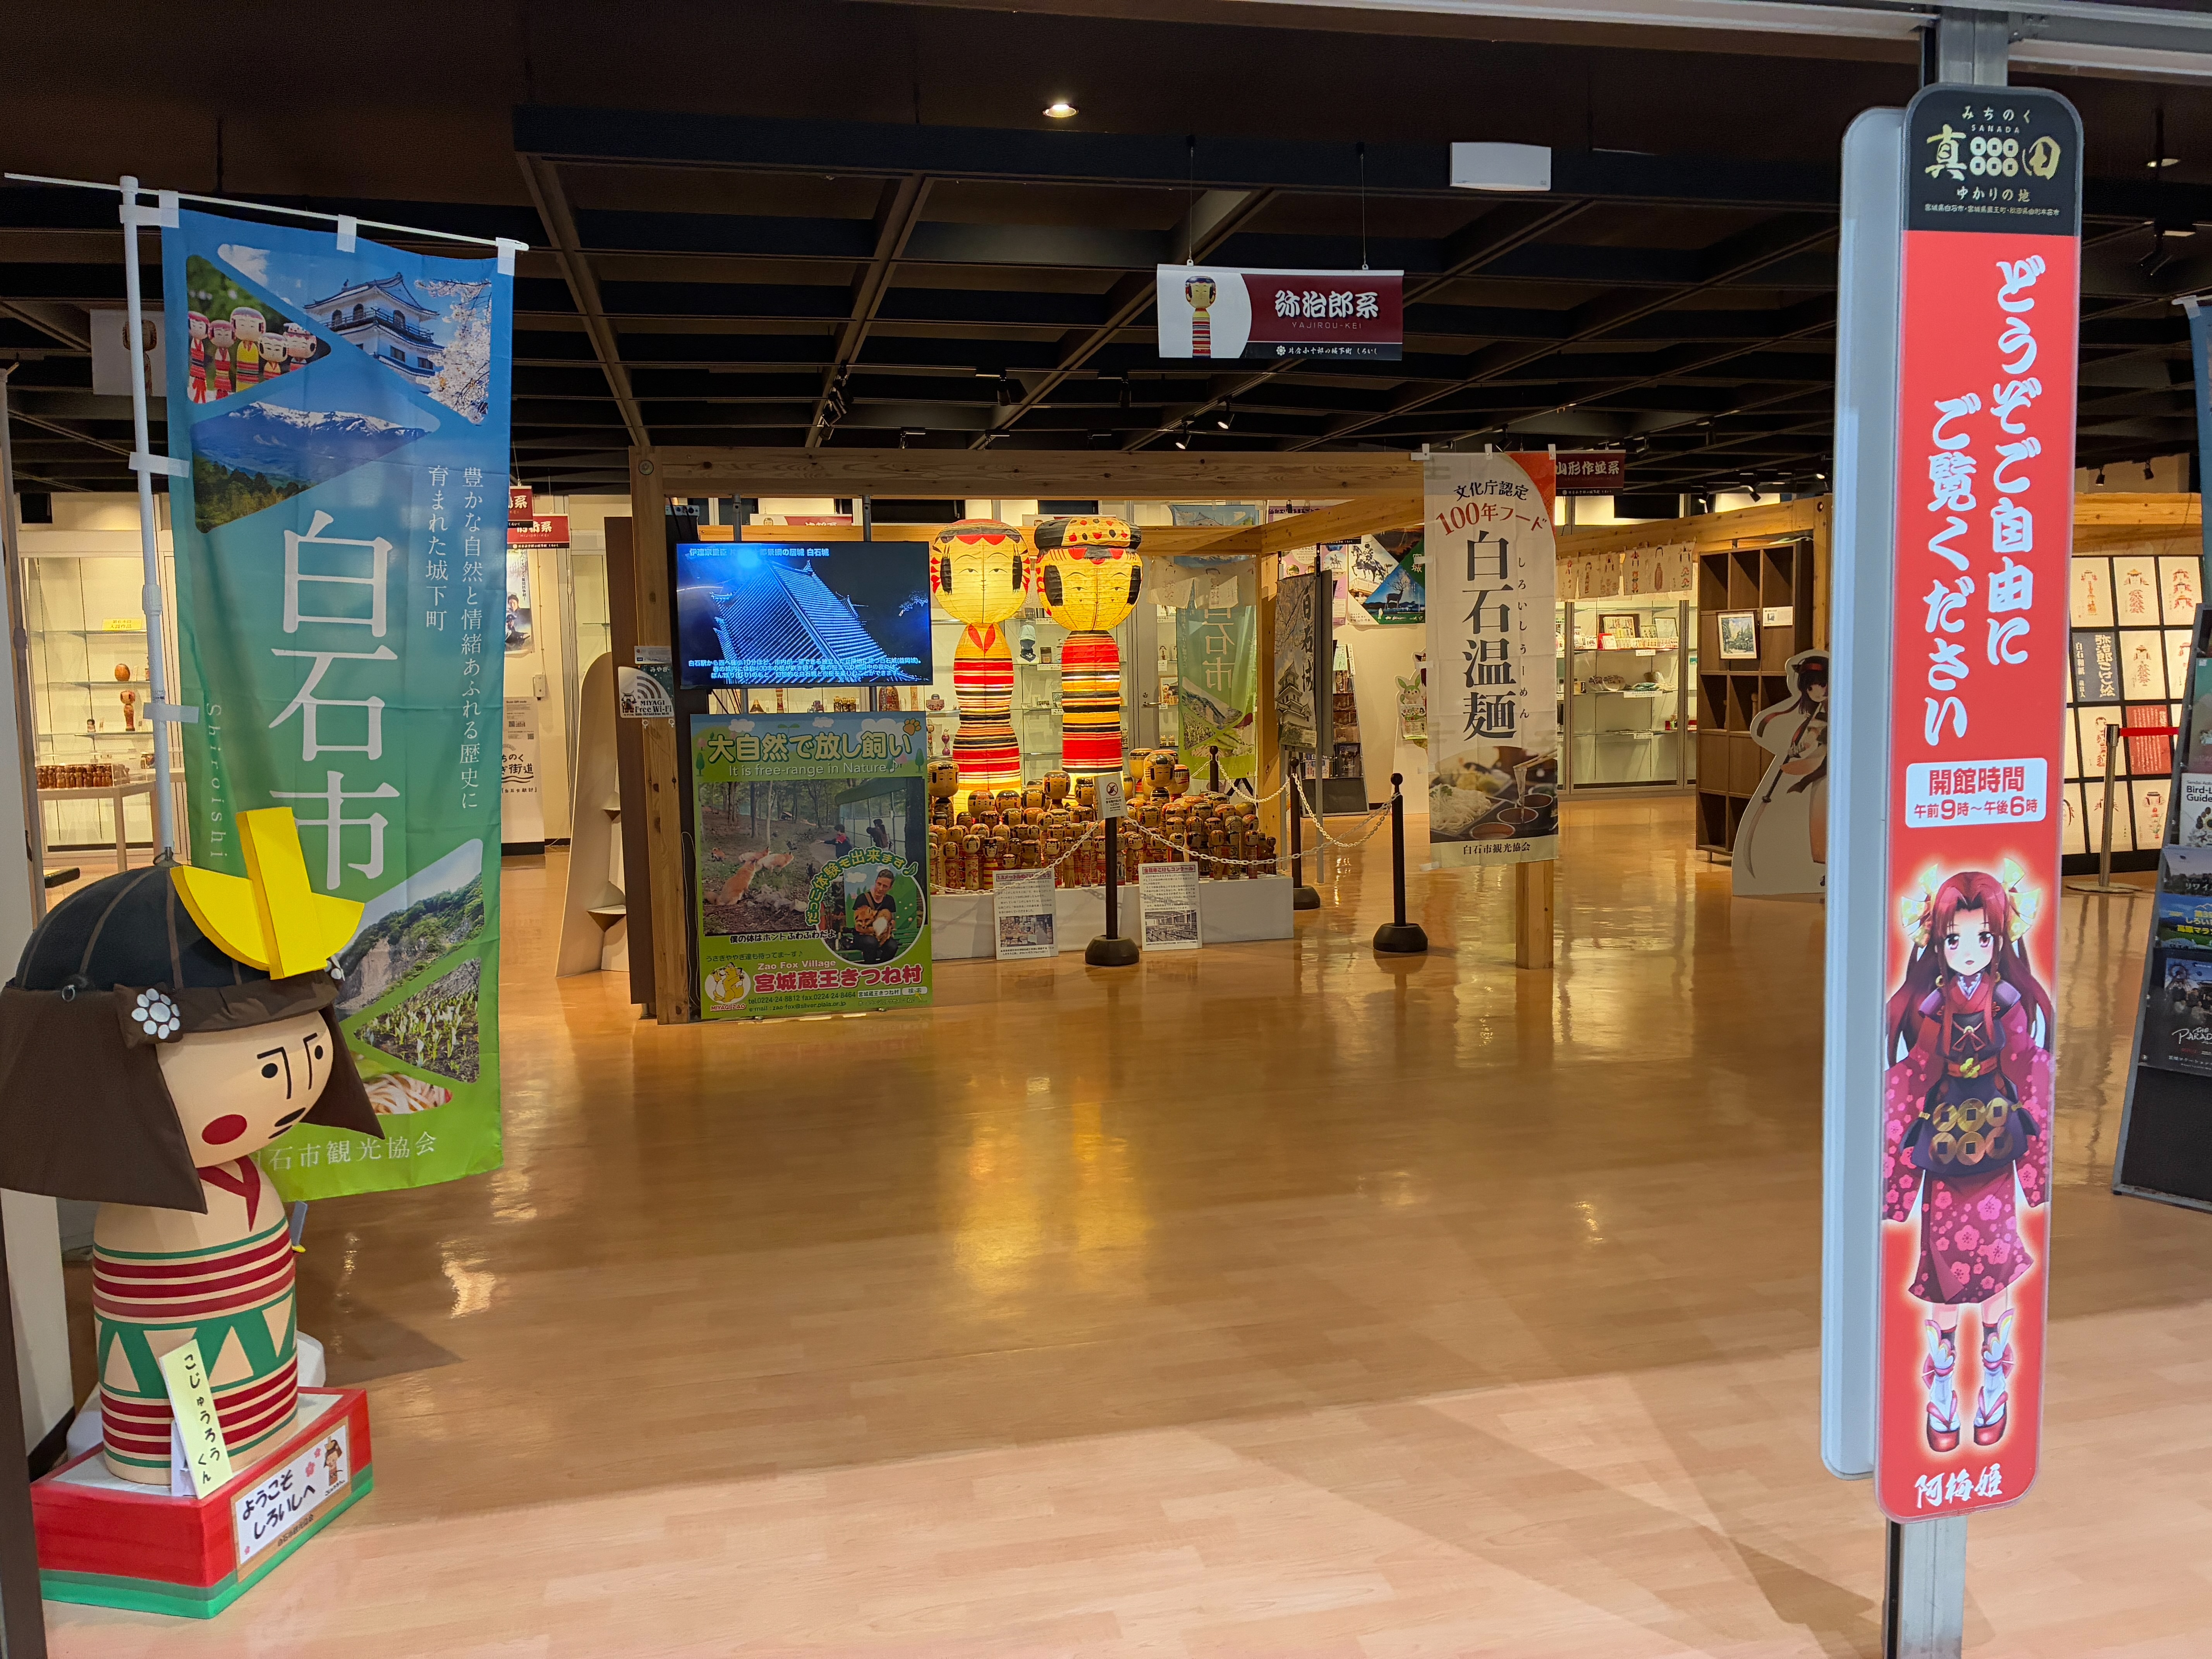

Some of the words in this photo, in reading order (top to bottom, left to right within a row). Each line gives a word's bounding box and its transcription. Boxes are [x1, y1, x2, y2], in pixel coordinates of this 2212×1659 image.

[1962, 105, 2030, 123] みちのく
[1971, 124, 2020, 134] SANADA
[1957, 185, 2031, 203] ゆかりの地
[1274, 290, 1379, 319] 弥治郎系
[1292, 321, 1362, 330] YAJIROU-KEI
[1555, 460, 1620, 476] 山形作並系
[1987, 254, 2046, 665] どうぞご自由に
[1453, 479, 1529, 502] 文化庁認定
[1436, 502, 1547, 536] 100年フード
[426, 465, 449, 631] 育まれた城下町
[1923, 392, 1982, 746] ご覧ください
[460, 467, 484, 809] 豊かな自然と情緒あふれる歴史に
[1462, 530, 1517, 741] 白石温麺
[1517, 557, 1530, 719] しろいしうーめん
[2095, 634, 2116, 698] 弥治郎こけし絵
[269, 510, 400, 890] 白石市
[708, 730, 912, 763] 大自然で放し飼い
[206, 703, 227, 858] Shiroishi
[729, 765, 738, 776] It
[742, 765, 752, 775] is
[756, 764, 824, 777] free-range
[828, 763, 839, 774] in
[843, 763, 887, 773] Nature
[1928, 766, 2025, 796] 開館時間
[1914, 797, 2039, 821] 午前9時〜午後6時
[1463, 842, 1531, 855] 白石市観光協会
[808, 848, 905, 924] だっこ体験も出来ます
[730, 929, 836, 944] 僕の体はホントふわふわだよ
[753, 964, 923, 993] 宮城蔵王きつね村
[780, 961, 798, 969] Fox
[802, 960, 836, 969] Village
[858, 989, 899, 997] 宮城蔵王きつね村
[184, 1354, 220, 1461] こじゅうろう
[198, 1453, 211, 1484] くん
[243, 1469, 293, 1521] ようこそ
[1914, 1463, 2003, 1509] 阿梅姫
[254, 1485, 316, 1539] しろいしへ
